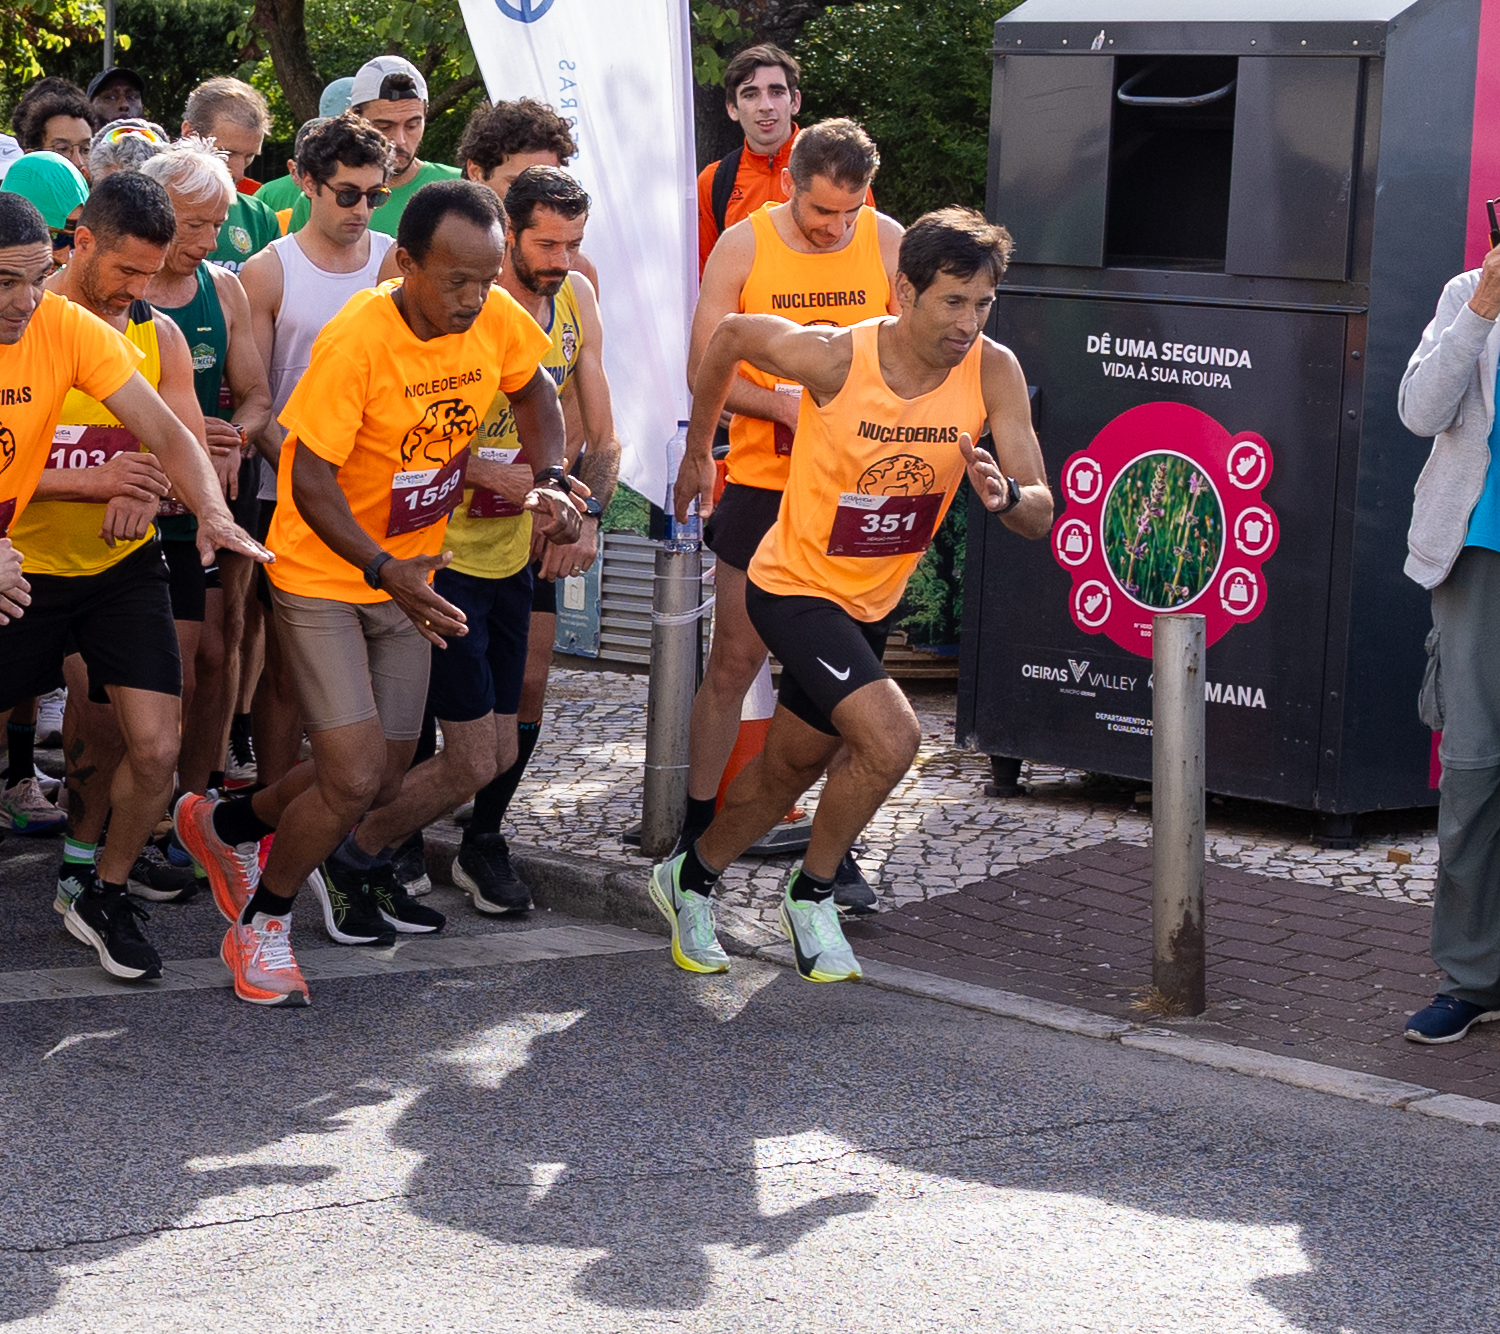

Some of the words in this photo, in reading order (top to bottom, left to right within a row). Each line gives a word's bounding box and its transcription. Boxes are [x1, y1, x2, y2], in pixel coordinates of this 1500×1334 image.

[772, 290, 866, 309] NUCLEOEIRAS
[1087, 332, 1111, 355] DÊ
[1115, 338, 1157, 360] UMA
[1161, 342, 1252, 369] SEGUNDA
[404, 368, 482, 398] NUCLEOEIRAS
[1102, 361, 1135, 380] VIDA
[1137, 362, 1148, 381] À
[1150, 366, 1179, 384] SUA
[1182, 369, 1232, 389] ROUPA
[857, 420, 959, 443] NUCLEOEIRAS
[405, 469, 461, 510] 1559
[860, 512, 917, 533] 351
[1022, 664, 1068, 682] OEIRAS
[1087, 672, 1138, 691] VALLEY
[1205, 682, 1267, 709] MANA
[1095, 712, 1145, 726] DEPARTAMENTO
[1112, 724, 1150, 736] QUALIDADE
